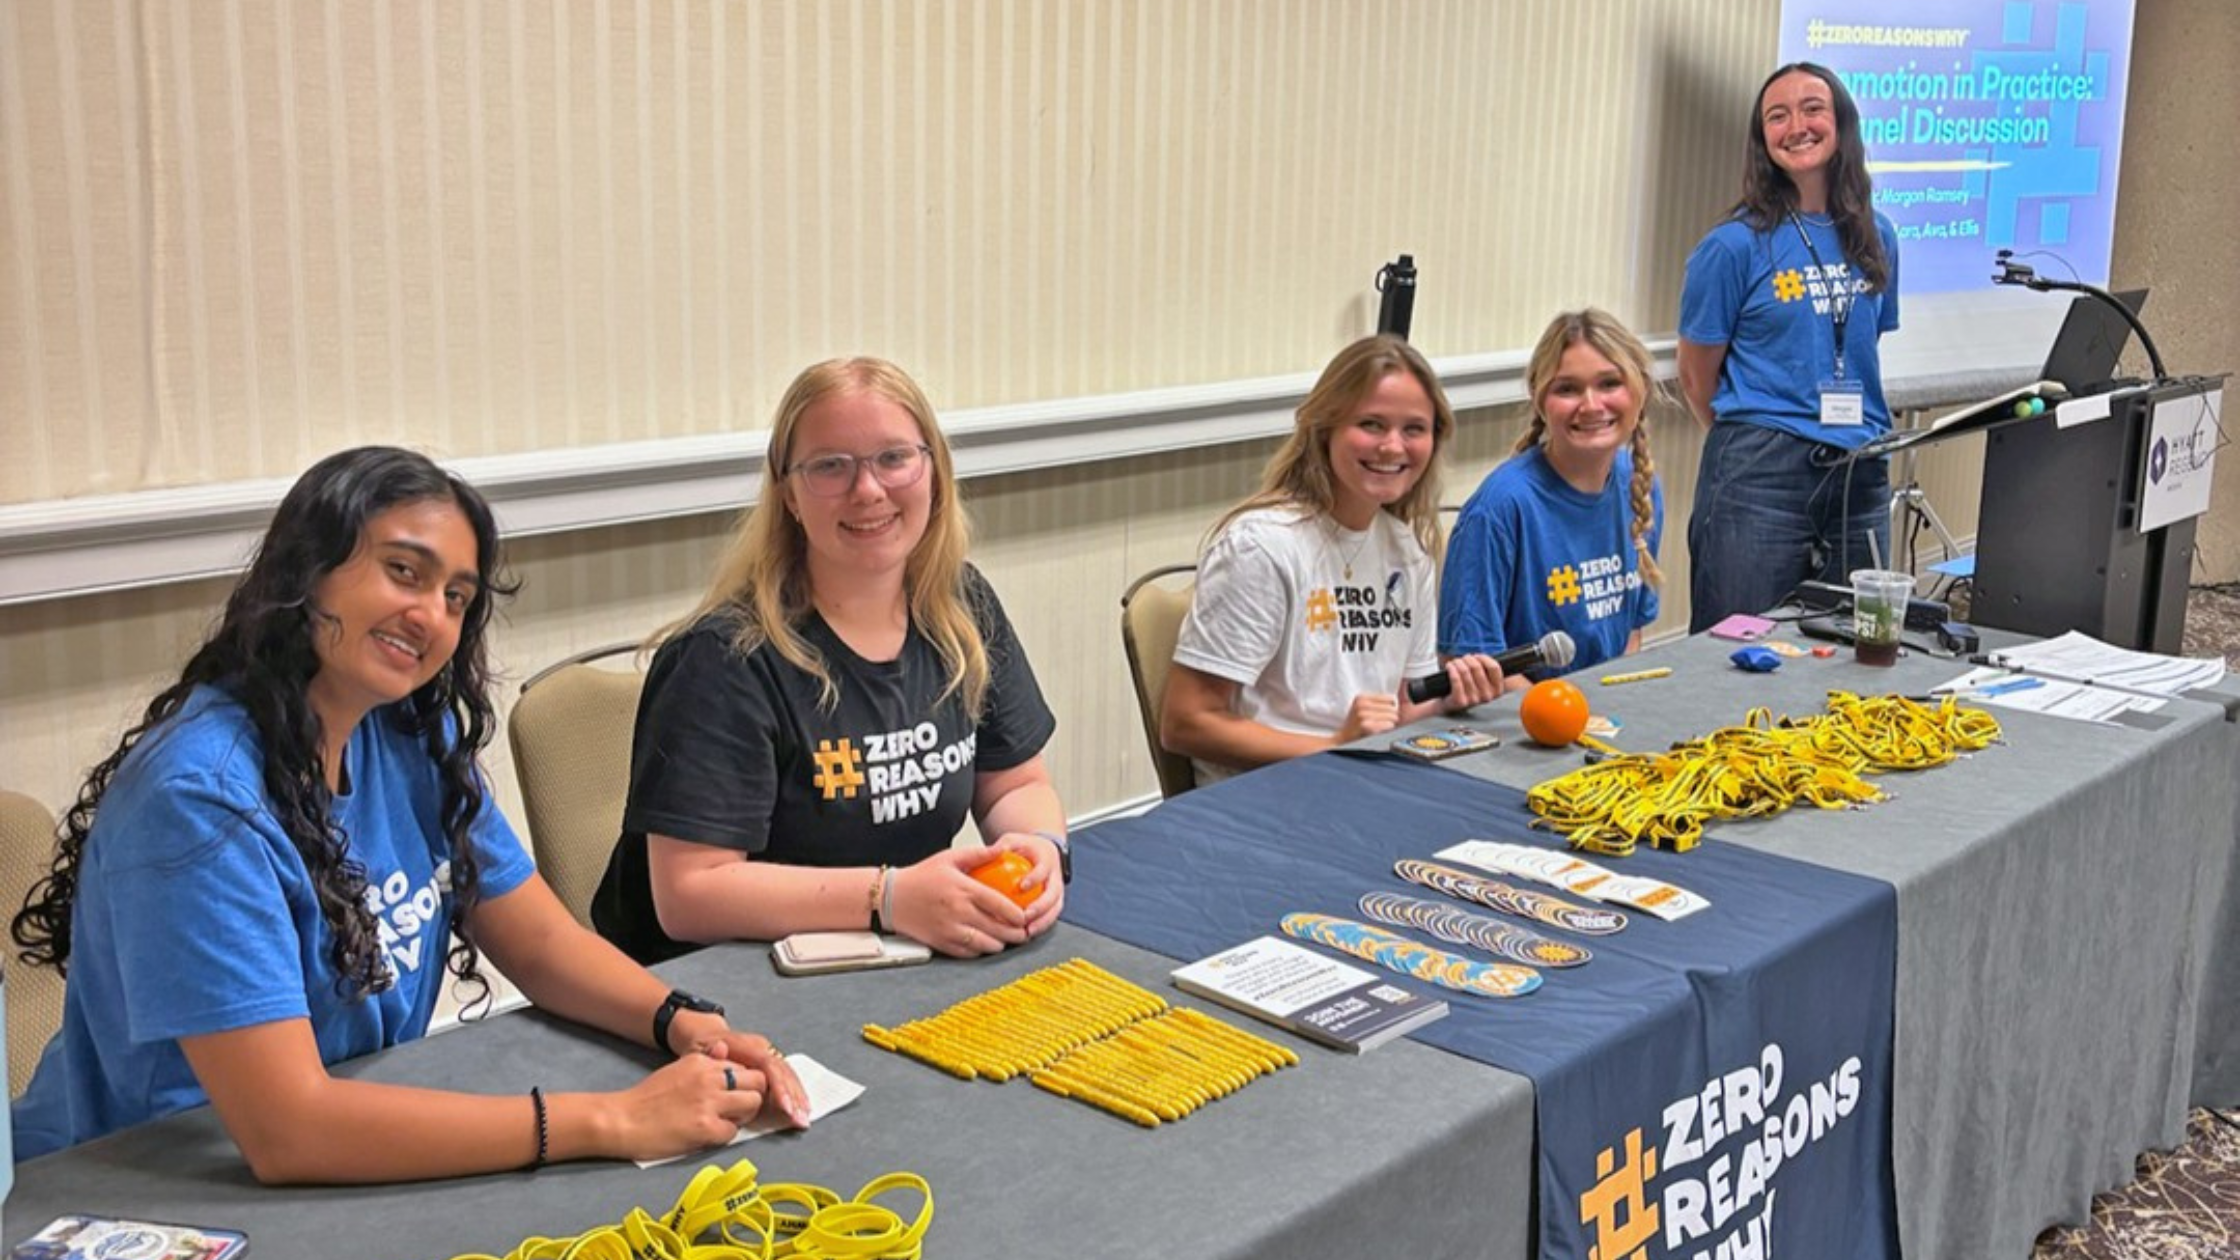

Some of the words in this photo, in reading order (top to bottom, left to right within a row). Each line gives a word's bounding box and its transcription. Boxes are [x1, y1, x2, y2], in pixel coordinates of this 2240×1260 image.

[1806, 19, 1969, 48] #ZEROREASONSWHY
[1953, 60, 1976, 100] in
[1981, 62, 2093, 100] Practice:
[1913, 105, 2049, 144] Discussion
[1579, 554, 1622, 580] ZERO
[1582, 571, 1642, 600] REASON
[1586, 594, 1623, 620] WHY
[863, 721, 938, 763] ZERO
[871, 782, 943, 825] WHY
[1661, 1042, 1784, 1173] ZERO
[1663, 1055, 1862, 1251] REASONS
[1691, 1187, 1776, 1260] HY
